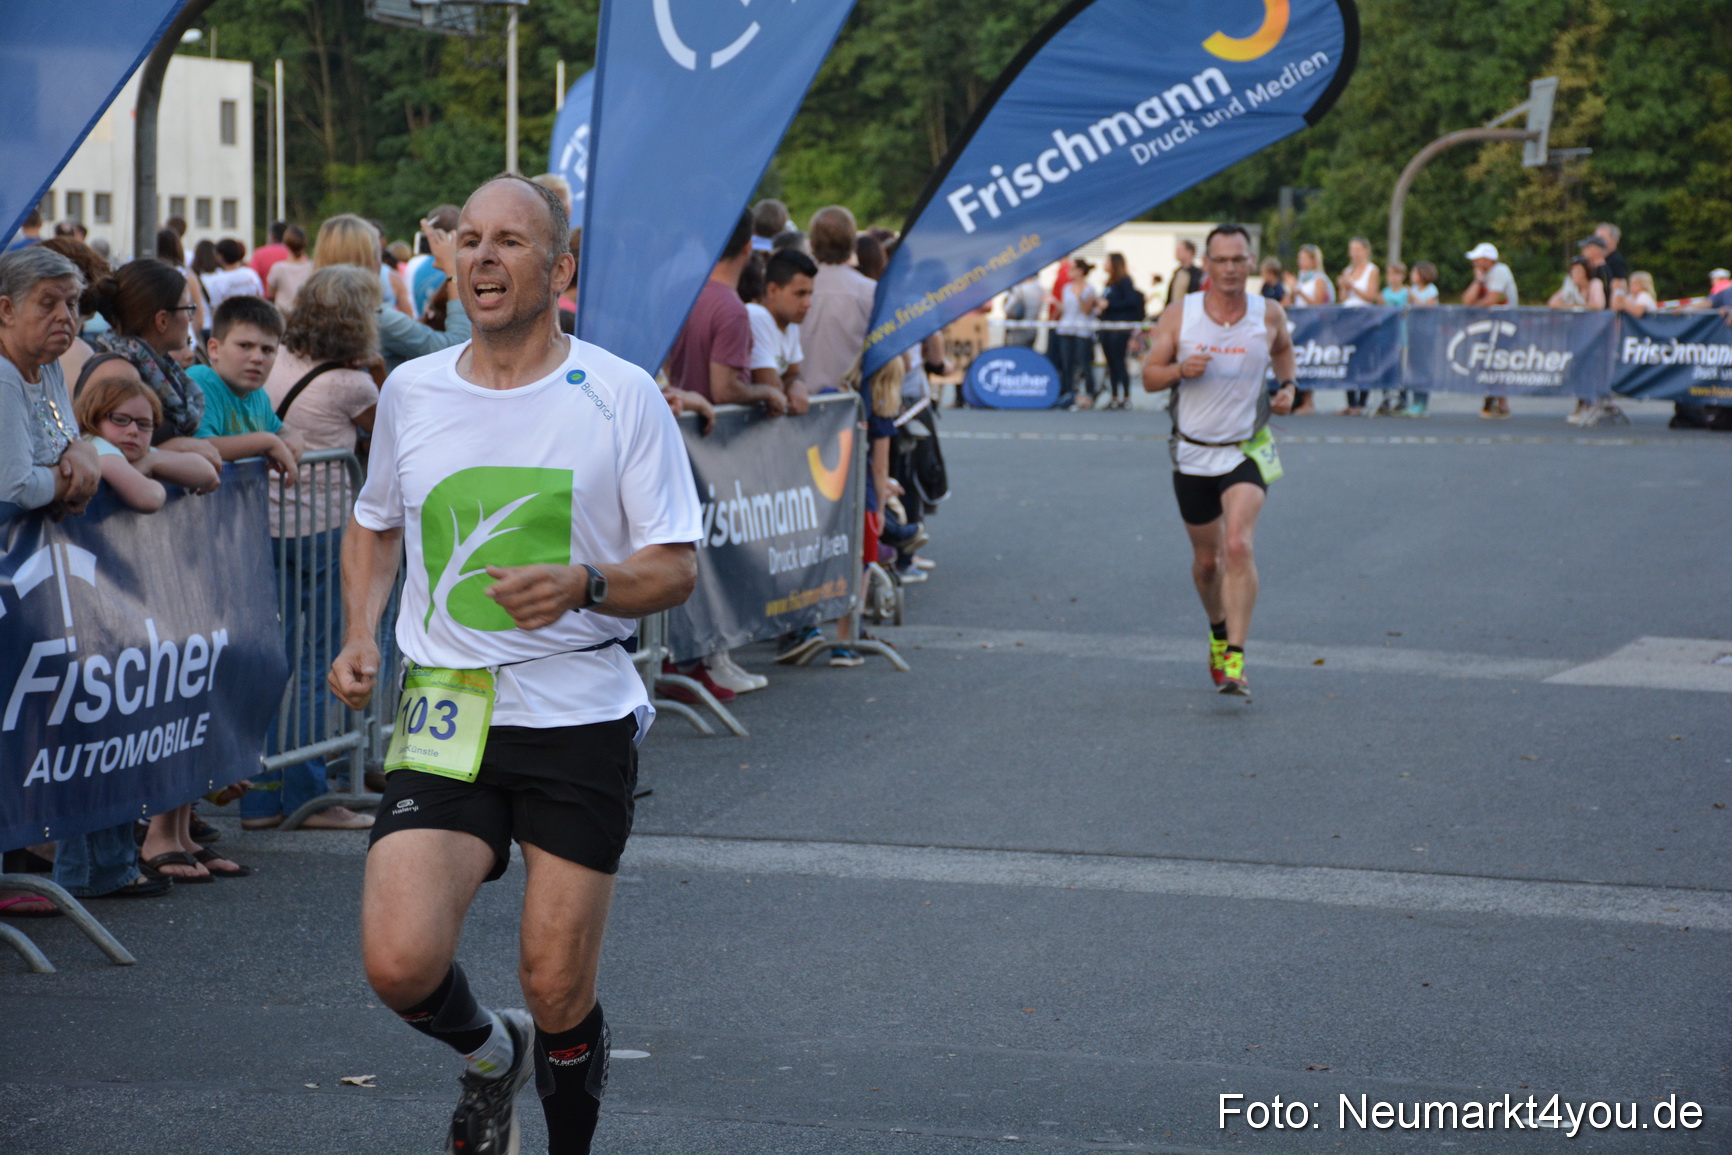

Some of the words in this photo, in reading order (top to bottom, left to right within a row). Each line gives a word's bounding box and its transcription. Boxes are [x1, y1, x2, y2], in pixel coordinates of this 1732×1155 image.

[1130, 118, 1199, 166] Druck
[1201, 96, 1246, 128] und
[1245, 51, 1330, 109] Medien
[947, 66, 1232, 234] Frischmann
[1467, 343, 1574, 372] Fischer
[1622, 335, 1732, 366] Frischman
[1477, 370, 1564, 387] AUTOMOBILE
[581, 382, 614, 421] Bionorica
[768, 541, 799, 576] Druck
[2, 618, 228, 732] Fischer
[402, 696, 458, 741] 103
[23, 712, 211, 787] AUTOMOBILE
[406, 744, 440, 758] Künstle
